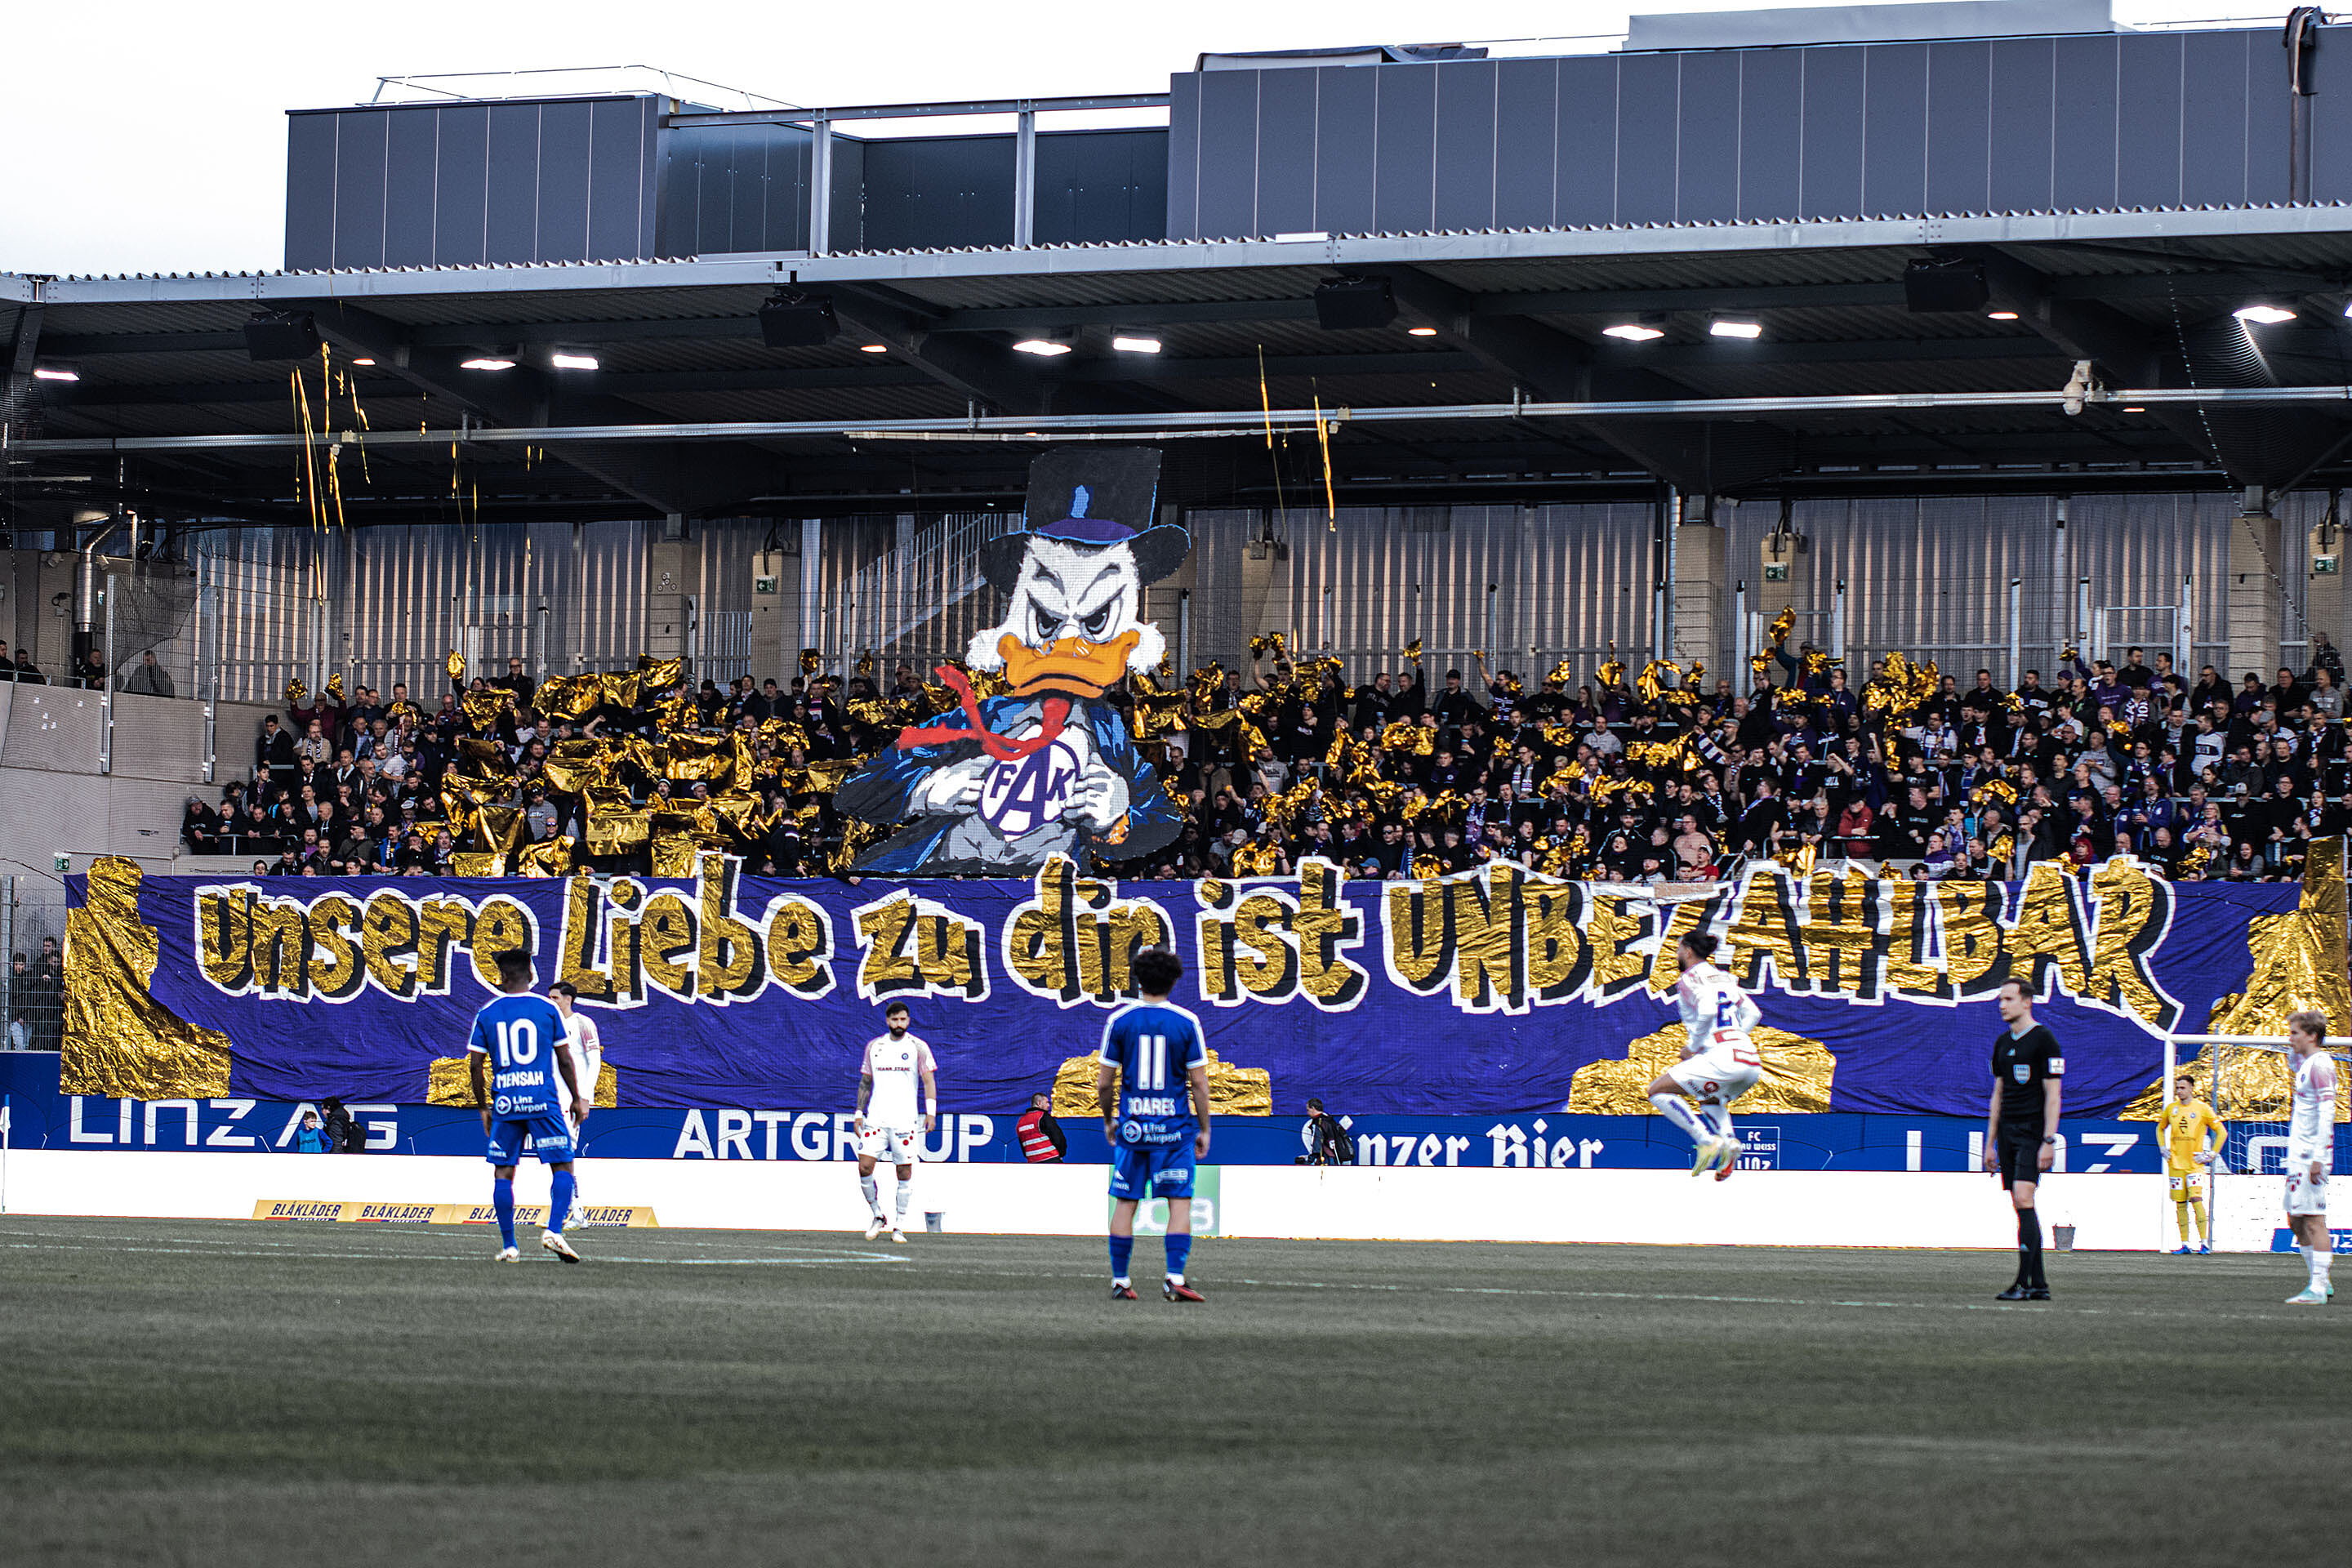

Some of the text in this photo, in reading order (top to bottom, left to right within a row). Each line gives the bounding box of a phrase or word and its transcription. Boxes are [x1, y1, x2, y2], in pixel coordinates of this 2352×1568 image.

[194, 881, 540, 1004] Unsere
[557, 850, 835, 1009] Liebe
[851, 887, 990, 1005] zu
[1195, 857, 1370, 1013] ist
[1381, 854, 2185, 1040] UNBEZAHLBAR
[496, 1018, 538, 1067] 10
[1137, 1033, 1166, 1091] 11
[496, 1071, 545, 1089] MENSAH
[513, 1095, 533, 1104] Linz
[514, 1102, 548, 1113] Airport
[69, 1095, 256, 1147] LINZ
[672, 1108, 995, 1163] ARTGRUP
[1747, 1131, 1762, 1142] FC
[1753, 1143, 1777, 1151] WEISS
[271, 1200, 342, 1217] BLÅKLÄDER
[361, 1202, 434, 1218] BLÅKLÄDER
